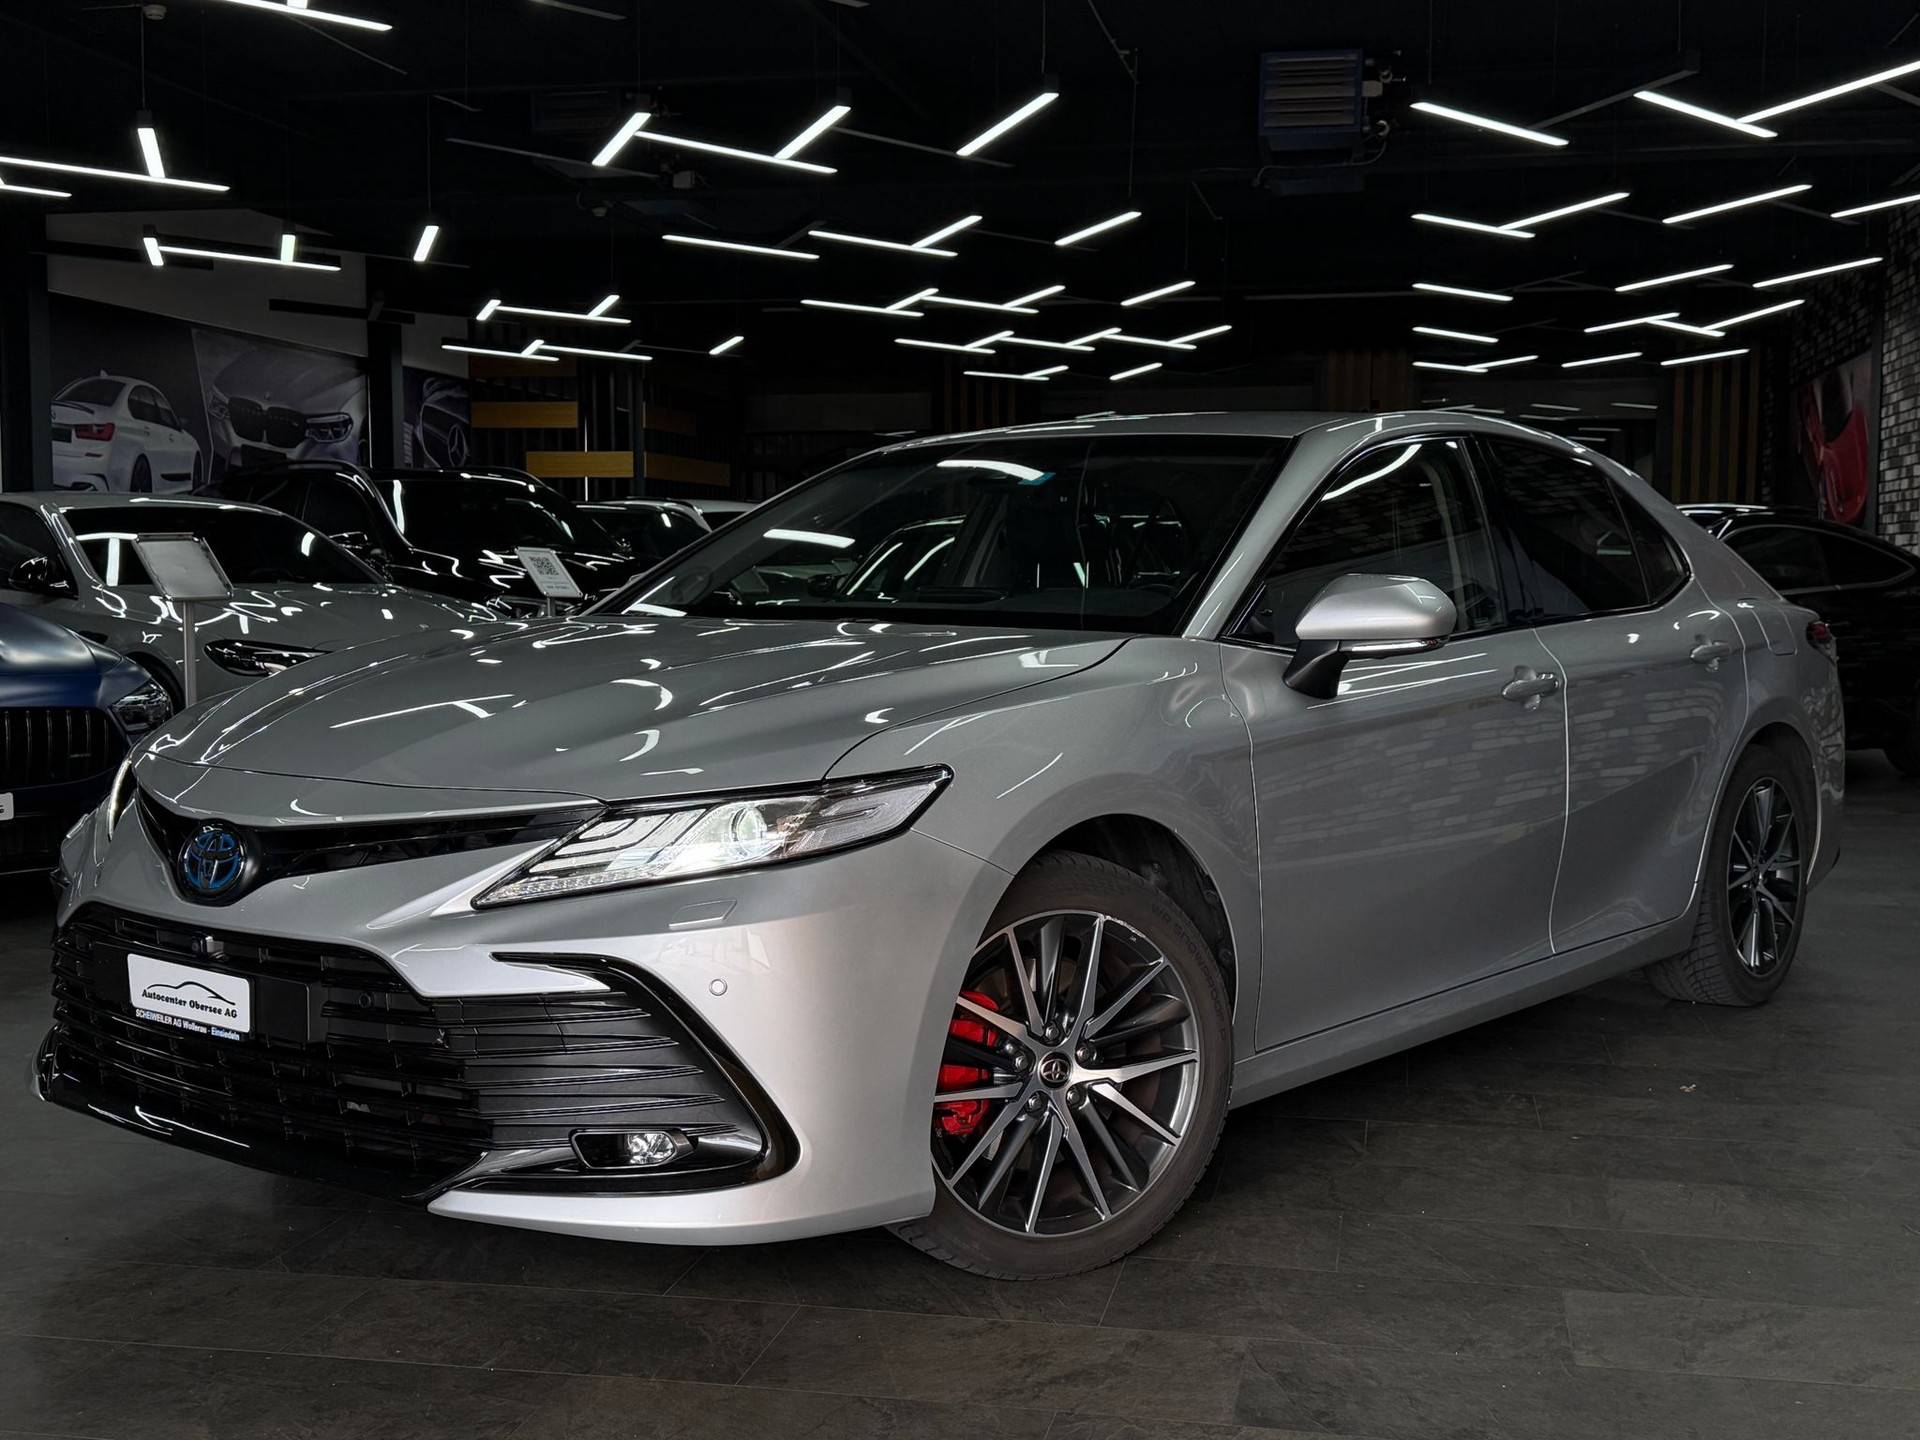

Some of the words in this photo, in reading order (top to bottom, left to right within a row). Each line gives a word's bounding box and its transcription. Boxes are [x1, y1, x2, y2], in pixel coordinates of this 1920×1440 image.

[142, 989, 187, 1006] Autocenter
[189, 1000, 222, 1015] Obersee
[224, 1008, 237, 1018] AG
[173, 1019, 182, 1027] AG
[183, 1020, 207, 1033] Wollerau
